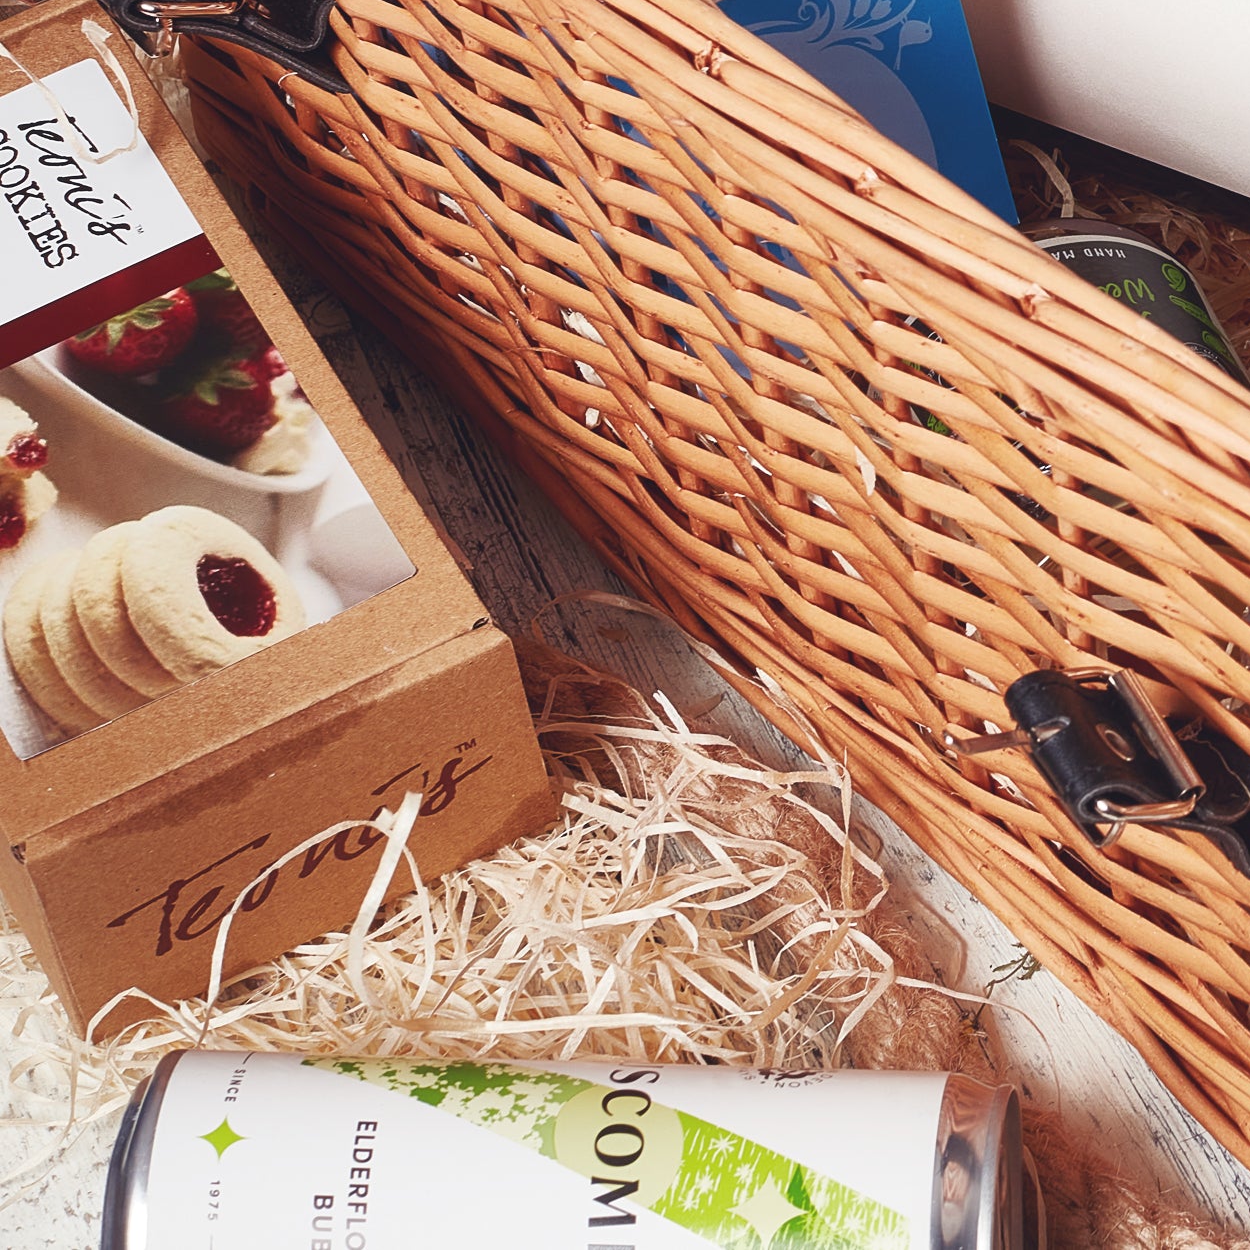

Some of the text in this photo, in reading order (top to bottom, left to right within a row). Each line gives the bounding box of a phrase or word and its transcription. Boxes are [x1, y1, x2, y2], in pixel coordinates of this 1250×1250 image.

[1083, 248, 1127, 259] HAND
[225, 1068, 247, 1103] SINCE
[207, 1179, 221, 1222] 1975
[345, 1120, 378, 1250] ELDERFLO
